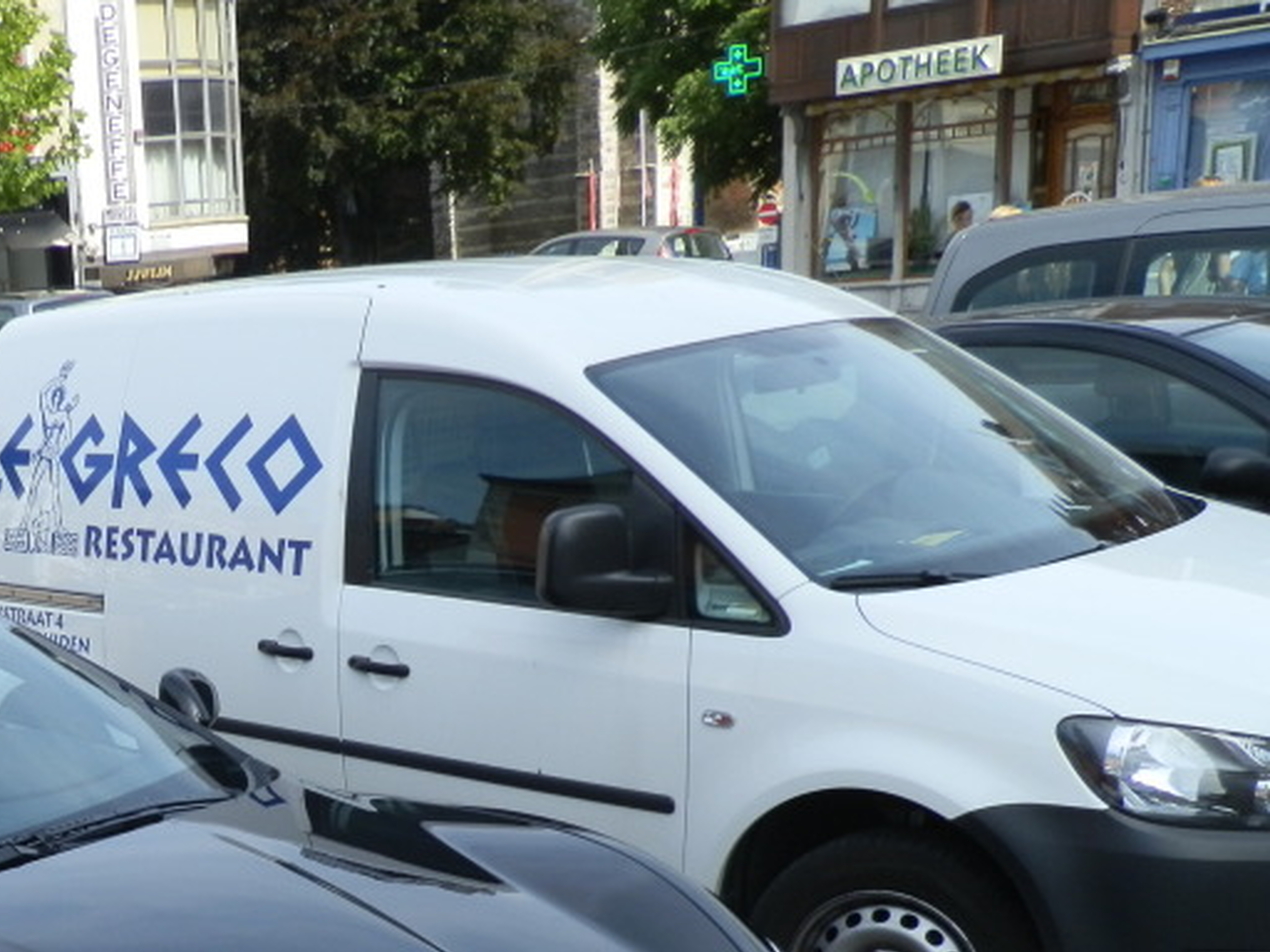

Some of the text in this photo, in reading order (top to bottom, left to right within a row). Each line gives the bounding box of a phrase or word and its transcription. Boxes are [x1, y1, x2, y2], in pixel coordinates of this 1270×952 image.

[839, 43, 991, 89] APOTHEEK
[99, 3, 127, 200] DEGENEFFE
[59, 410, 324, 516] GRECO
[83, 524, 313, 577] RESTAURANT
[54, 613, 63, 629] 4
